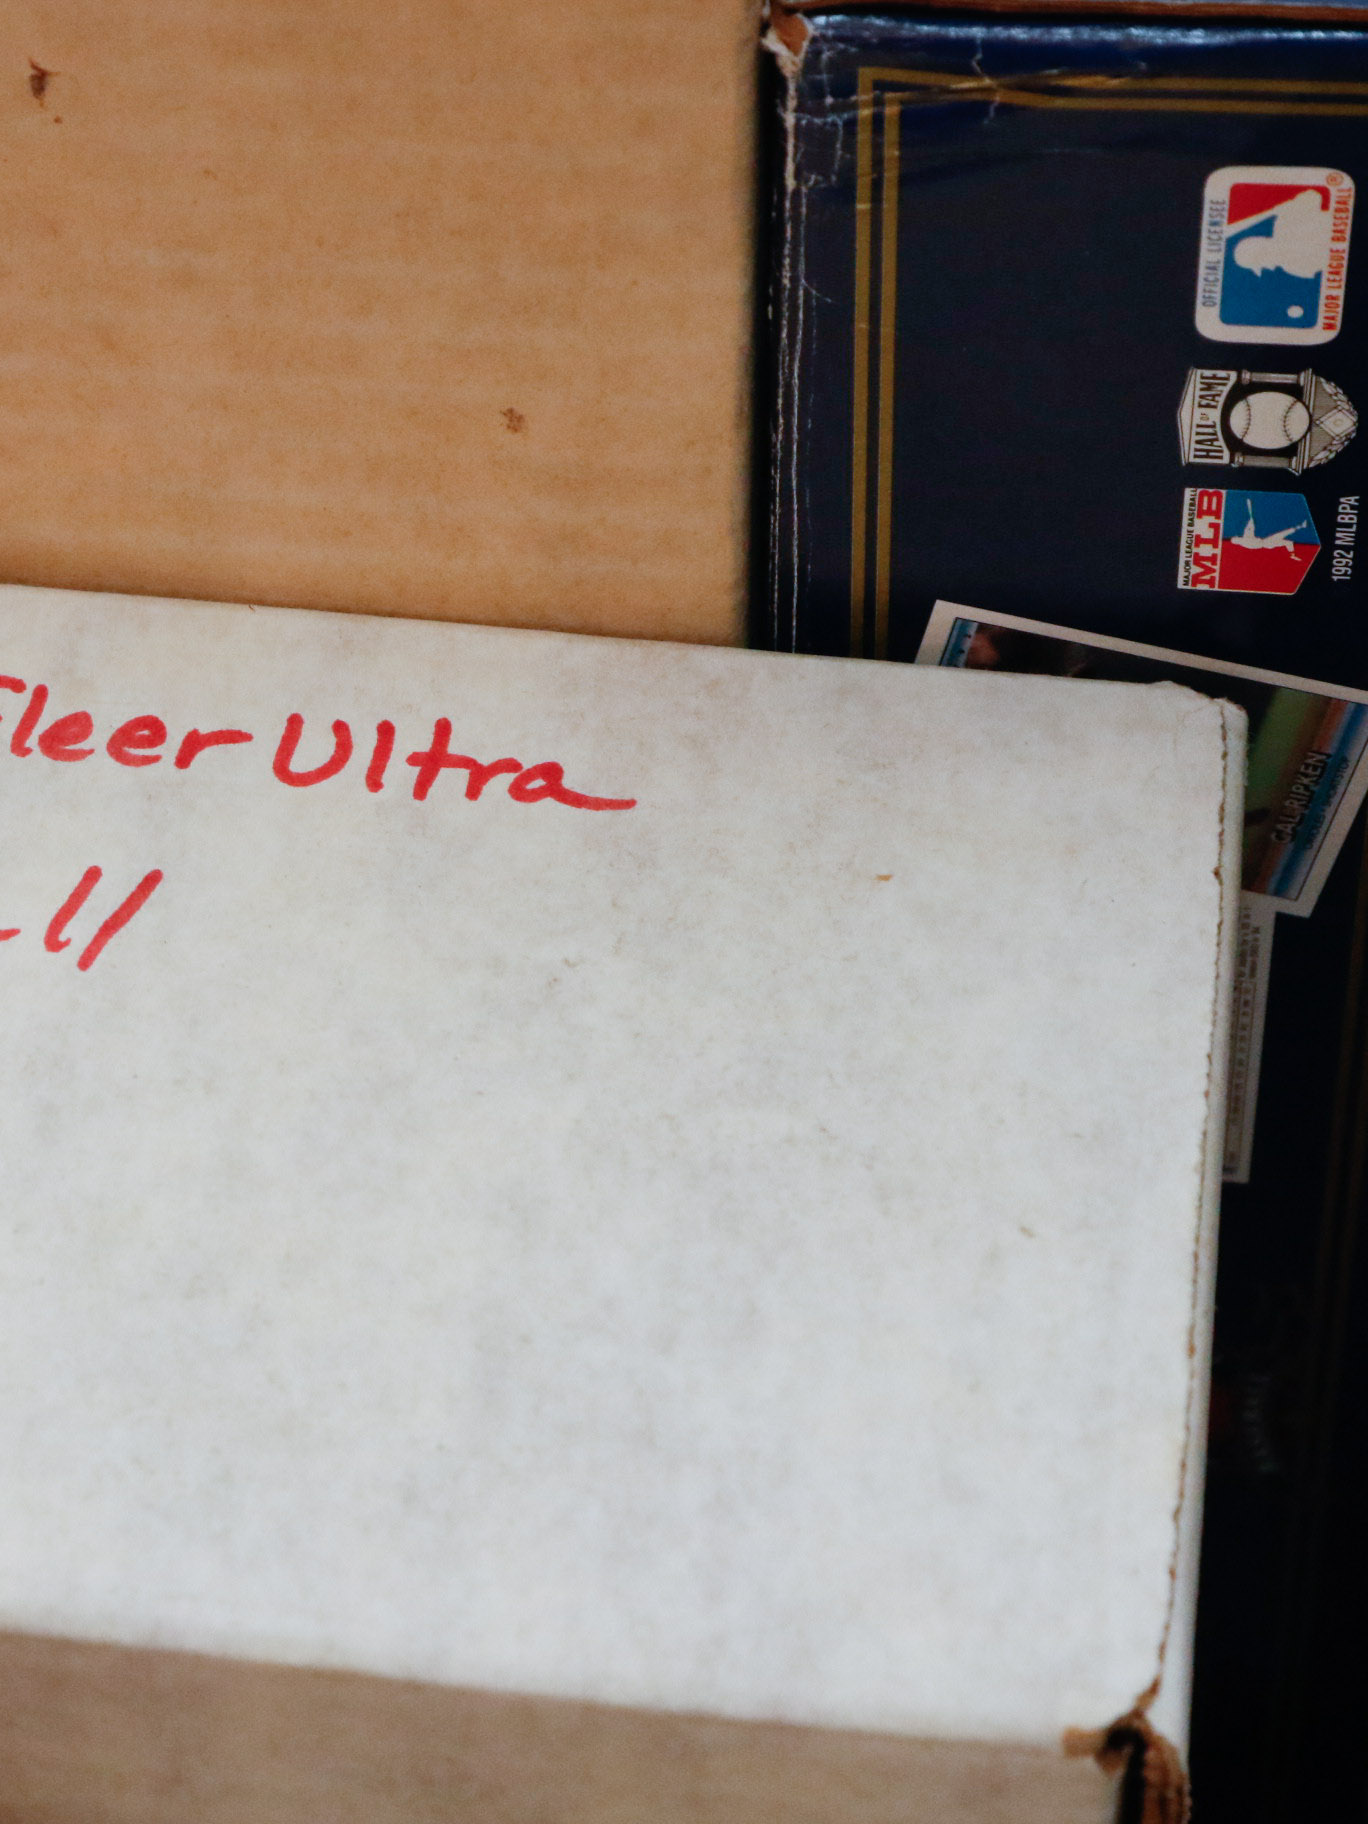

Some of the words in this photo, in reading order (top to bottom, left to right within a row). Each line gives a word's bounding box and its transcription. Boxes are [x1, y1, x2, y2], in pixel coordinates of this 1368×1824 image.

[1208, 199, 1225, 253] LICENSEE
[1331, 187, 1351, 242] BASEBALL
[1202, 259, 1220, 307] OFFICIAL
[1327, 248, 1346, 289] LEAGUE
[1323, 294, 1341, 330] MAJOR
[1195, 372, 1231, 409] FAME
[1193, 421, 1224, 460] HALL
[1187, 488, 1197, 527] BASEBALL
[1335, 495, 1360, 546] MLBPA
[1184, 529, 1195, 558] LEAGUE
[1191, 488, 1224, 589] MLB
[1183, 560, 1192, 586] MAJOR
[1331, 549, 1355, 582] 1992
[273, 713, 636, 811] Ultra
[1284, 750, 1330, 813] RIPKEN
[1270, 814, 1302, 844] CAL
